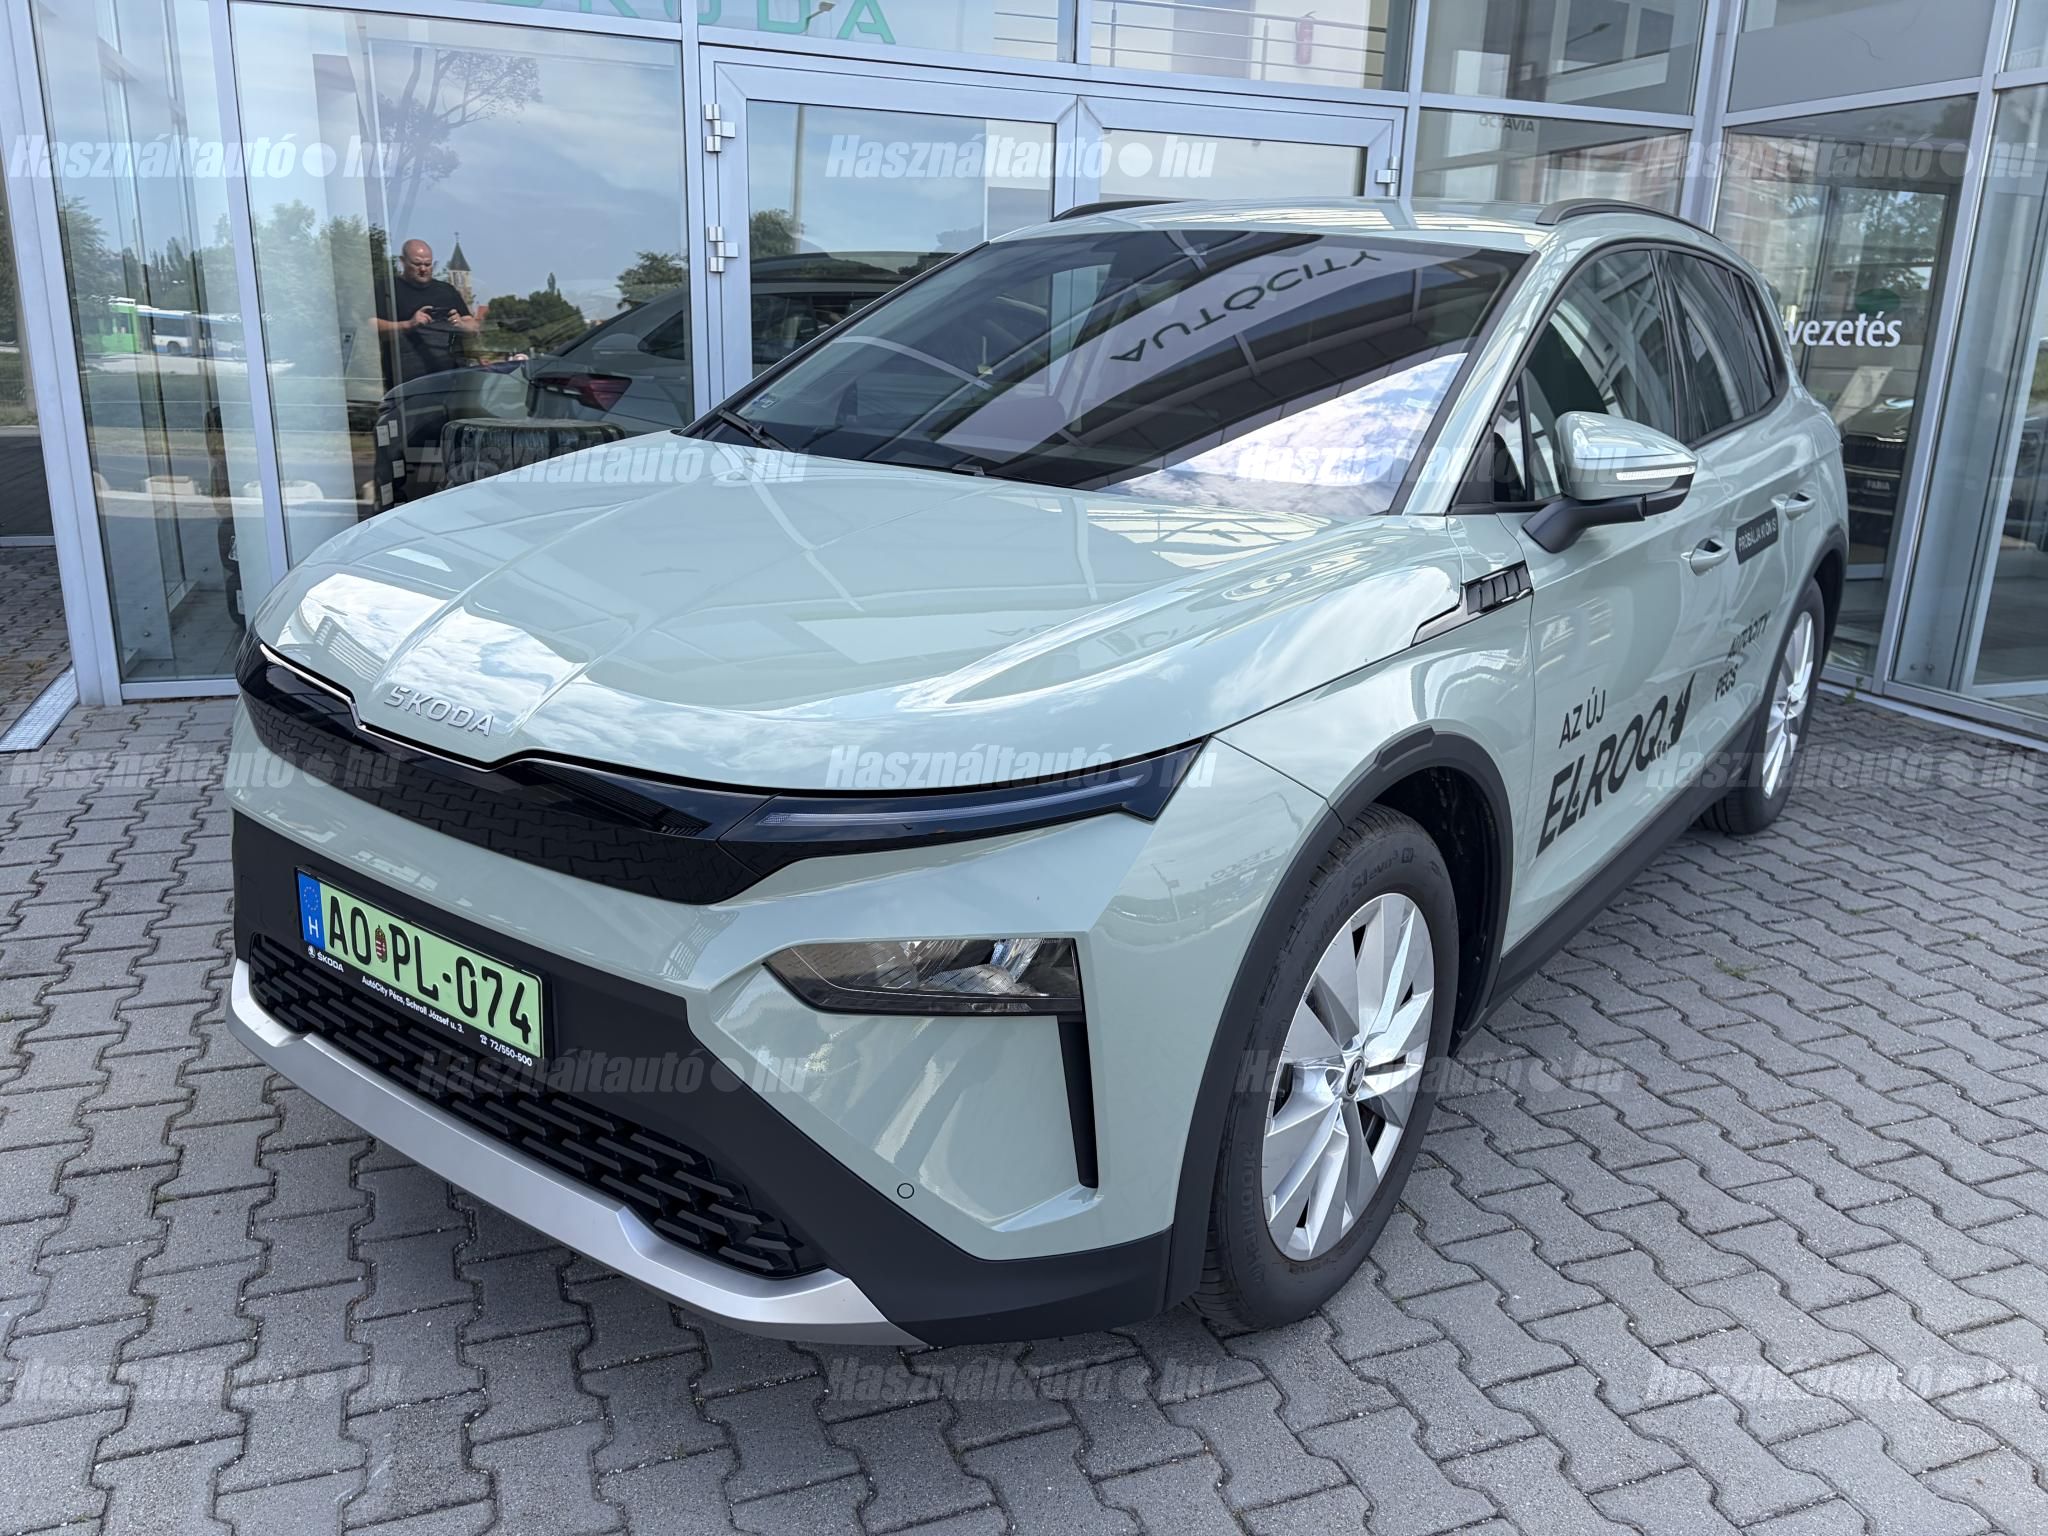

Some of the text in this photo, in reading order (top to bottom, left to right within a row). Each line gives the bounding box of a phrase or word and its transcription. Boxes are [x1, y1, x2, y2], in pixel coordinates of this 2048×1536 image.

[1786, 311, 1902, 347] vezetés
[1559, 686, 1606, 749] AZ ÚJ
[1535, 694, 1670, 858] ELROQ
[308, 916, 319, 938] H
[329, 895, 372, 966] AO
[490, 1038, 533, 1067] 72/550-500
